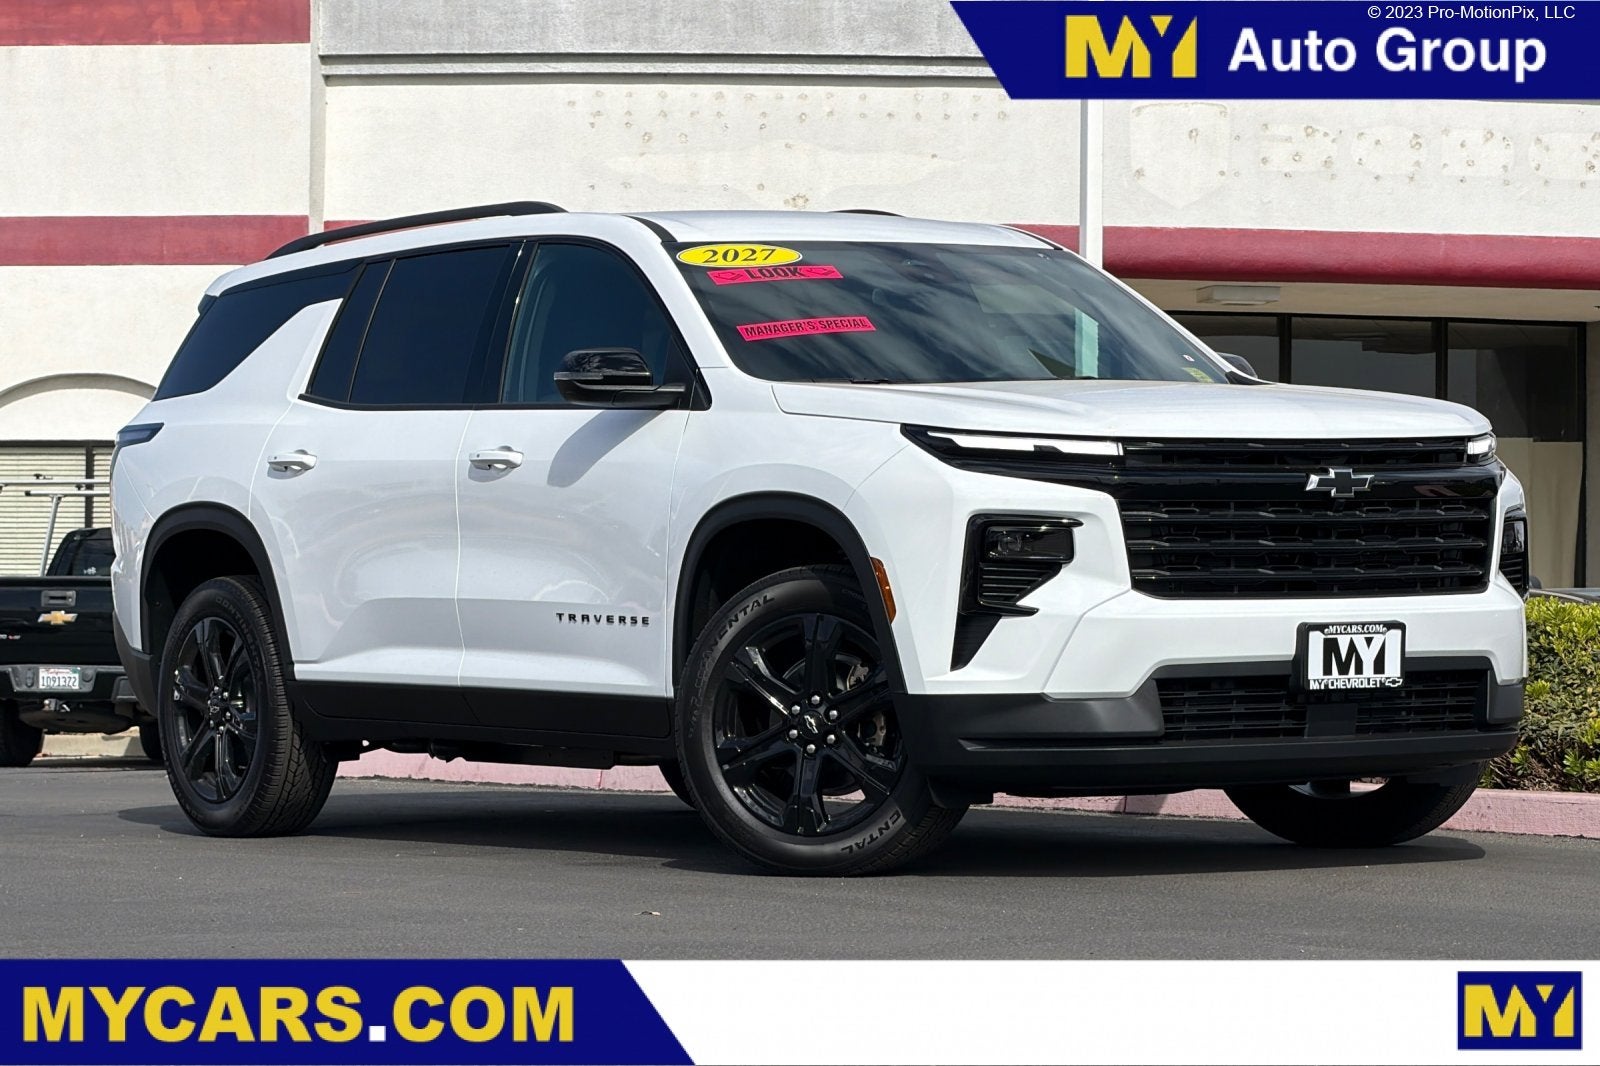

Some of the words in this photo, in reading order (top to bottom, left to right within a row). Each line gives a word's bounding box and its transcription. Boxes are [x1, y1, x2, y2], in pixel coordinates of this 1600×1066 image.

[702, 248, 776, 264] 2027
[744, 266, 804, 279] LOOK
[744, 320, 817, 337] MANAGER'S
[818, 317, 868, 330] SPECIAL
[556, 612, 650, 626] TRAVERSE
[1322, 636, 1386, 677] MY
[1309, 679, 1325, 690] MY
[1328, 678, 1381, 689] CHEVROLET
